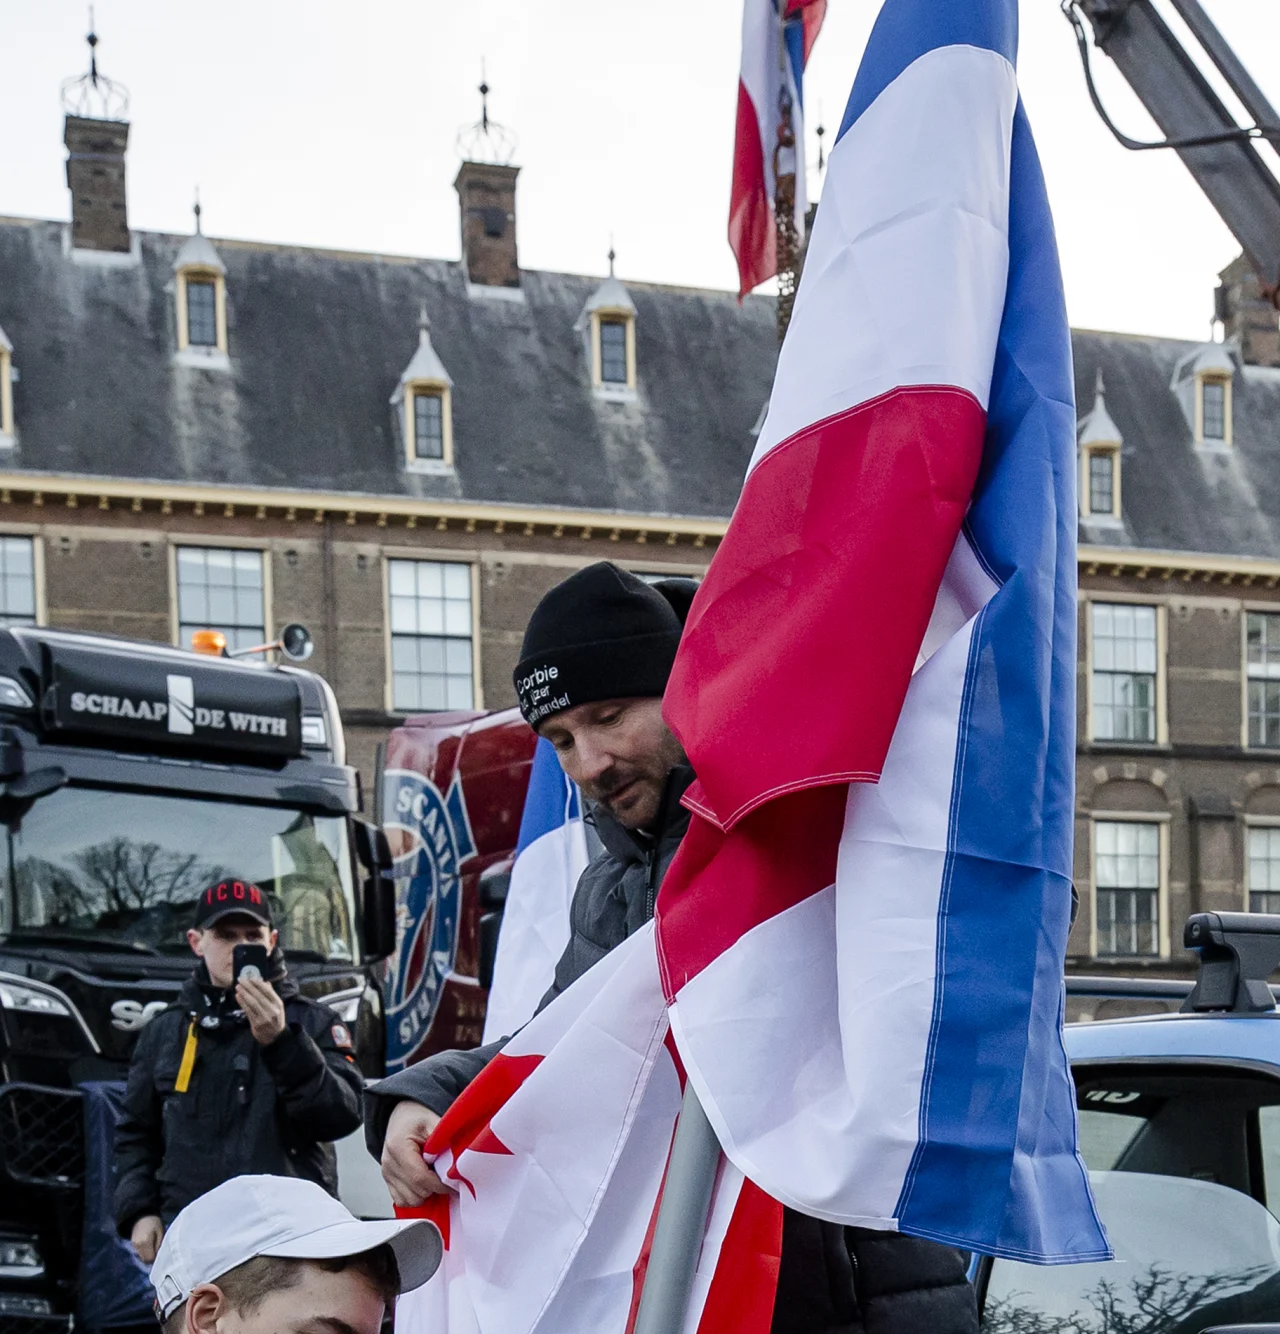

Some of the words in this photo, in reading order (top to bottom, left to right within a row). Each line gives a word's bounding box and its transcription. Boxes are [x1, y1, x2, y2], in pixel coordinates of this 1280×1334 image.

[70, 691, 168, 722] SCHAAP
[194, 707, 226, 729] DE
[228, 711, 288, 738] WITH
[395, 785, 454, 899] SCANIA
[205, 881, 262, 905] ICON
